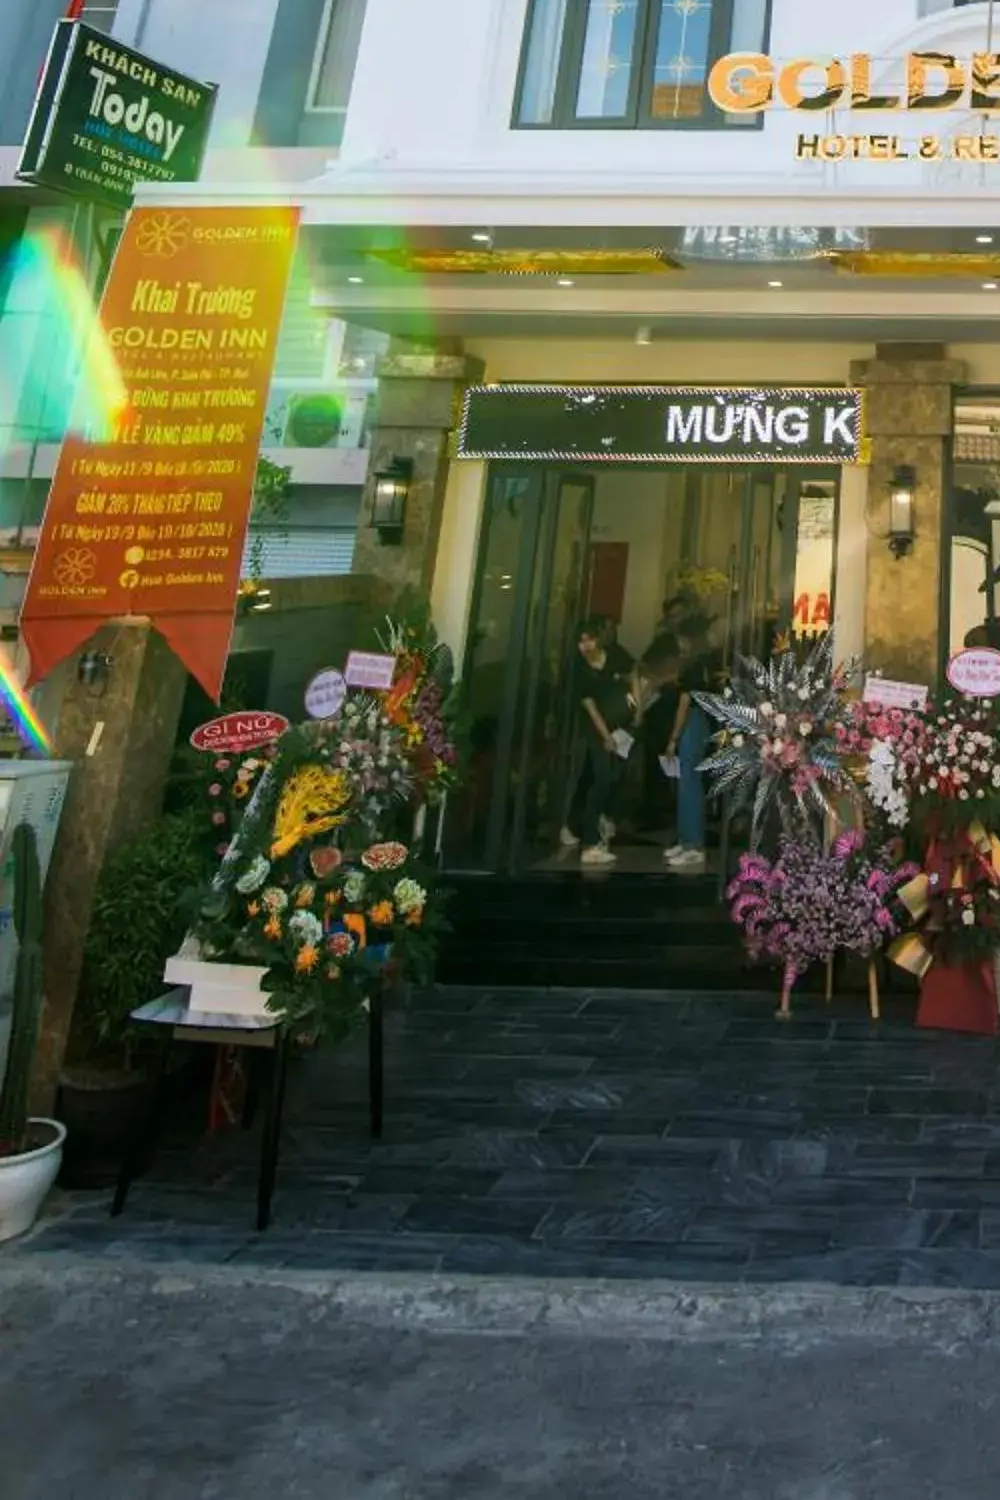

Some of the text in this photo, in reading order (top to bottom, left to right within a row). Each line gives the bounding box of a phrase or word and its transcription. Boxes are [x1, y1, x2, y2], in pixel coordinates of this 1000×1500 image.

[89, 66, 185, 161] Today
[796, 133, 909, 161] HOTEL
[919, 134, 941, 160] &
[192, 226, 258, 240] GOLDEN
[131, 279, 257, 319] Khai Trương
[108, 326, 268, 349] GOLDEN INN
[216, 422, 246, 443] 49%
[665, 395, 857, 445] MỪNG K
